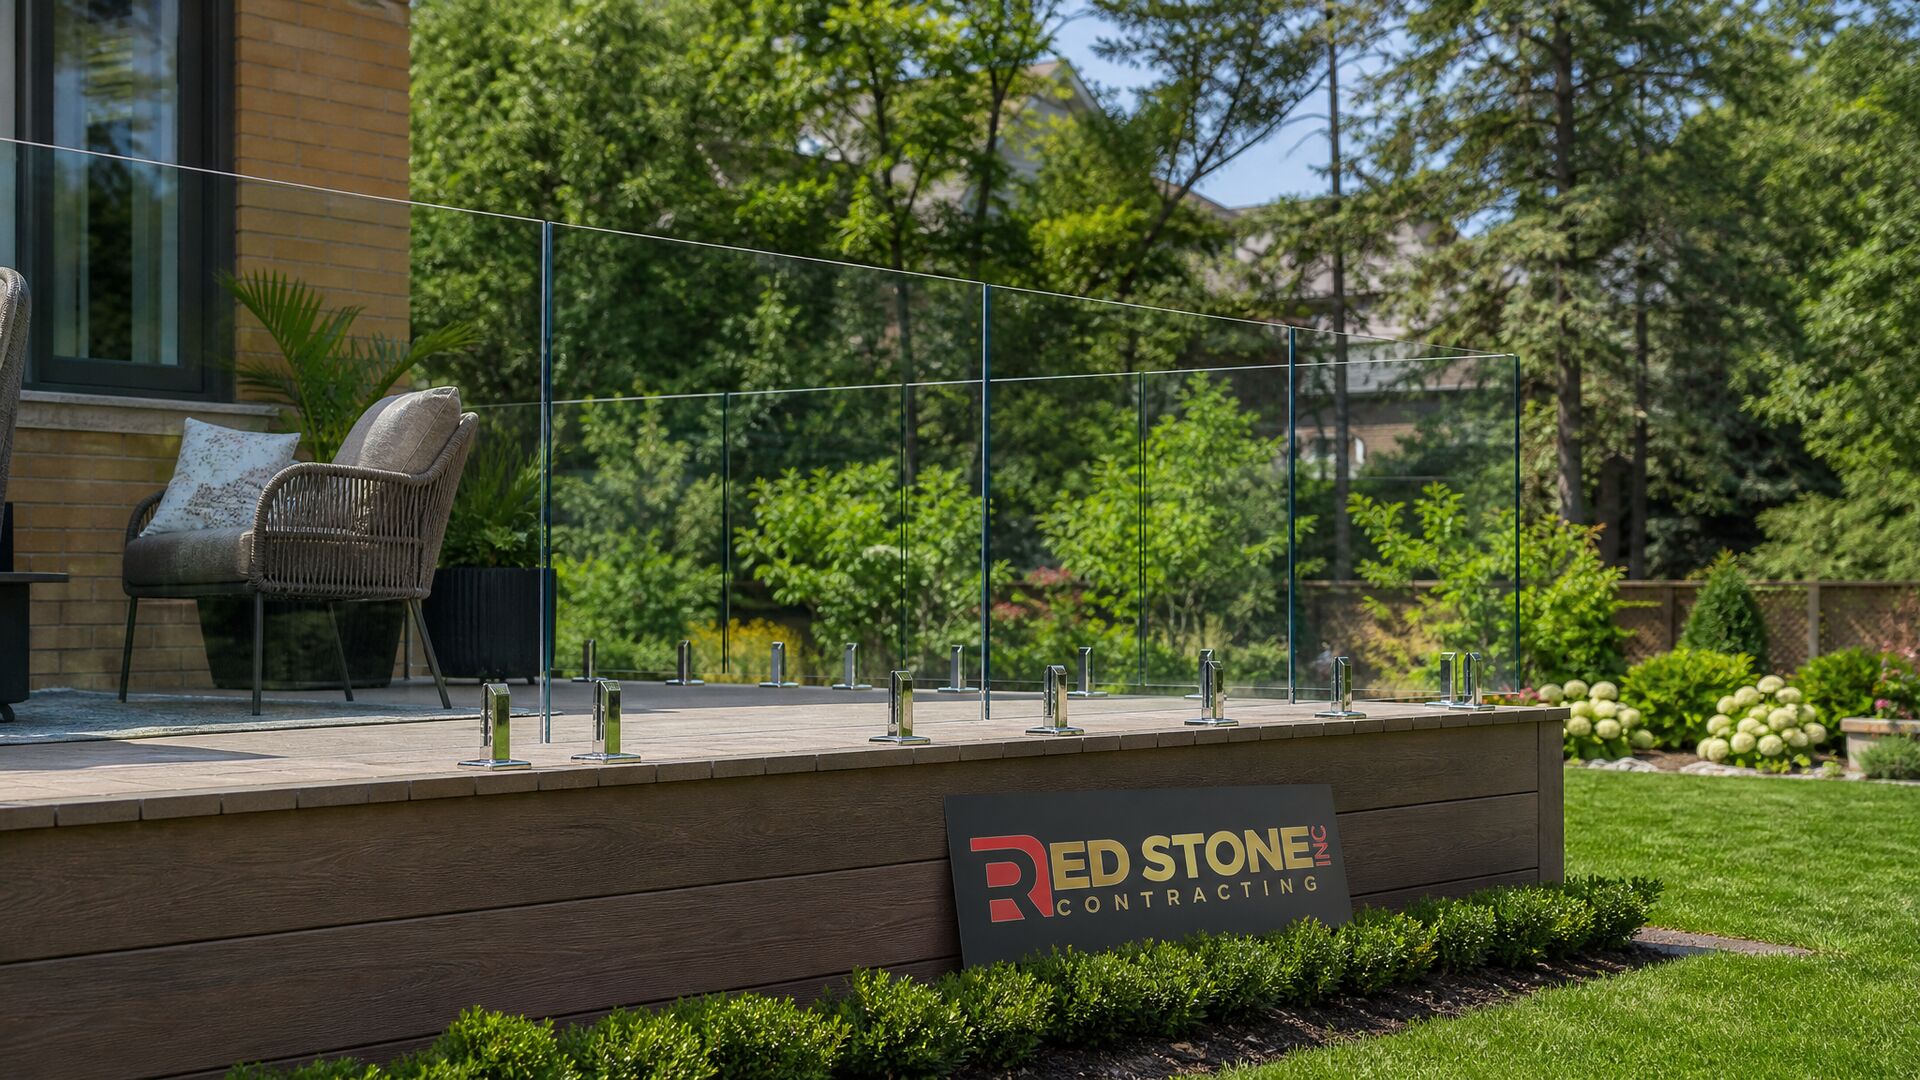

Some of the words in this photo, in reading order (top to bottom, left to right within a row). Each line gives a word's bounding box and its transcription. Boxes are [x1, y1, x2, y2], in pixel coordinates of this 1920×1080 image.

[1311, 824, 1332, 867] INC
[970, 834, 1130, 923] RED
[1141, 826, 1314, 882] STONE
[1056, 875, 1318, 917] CONTRACTING
